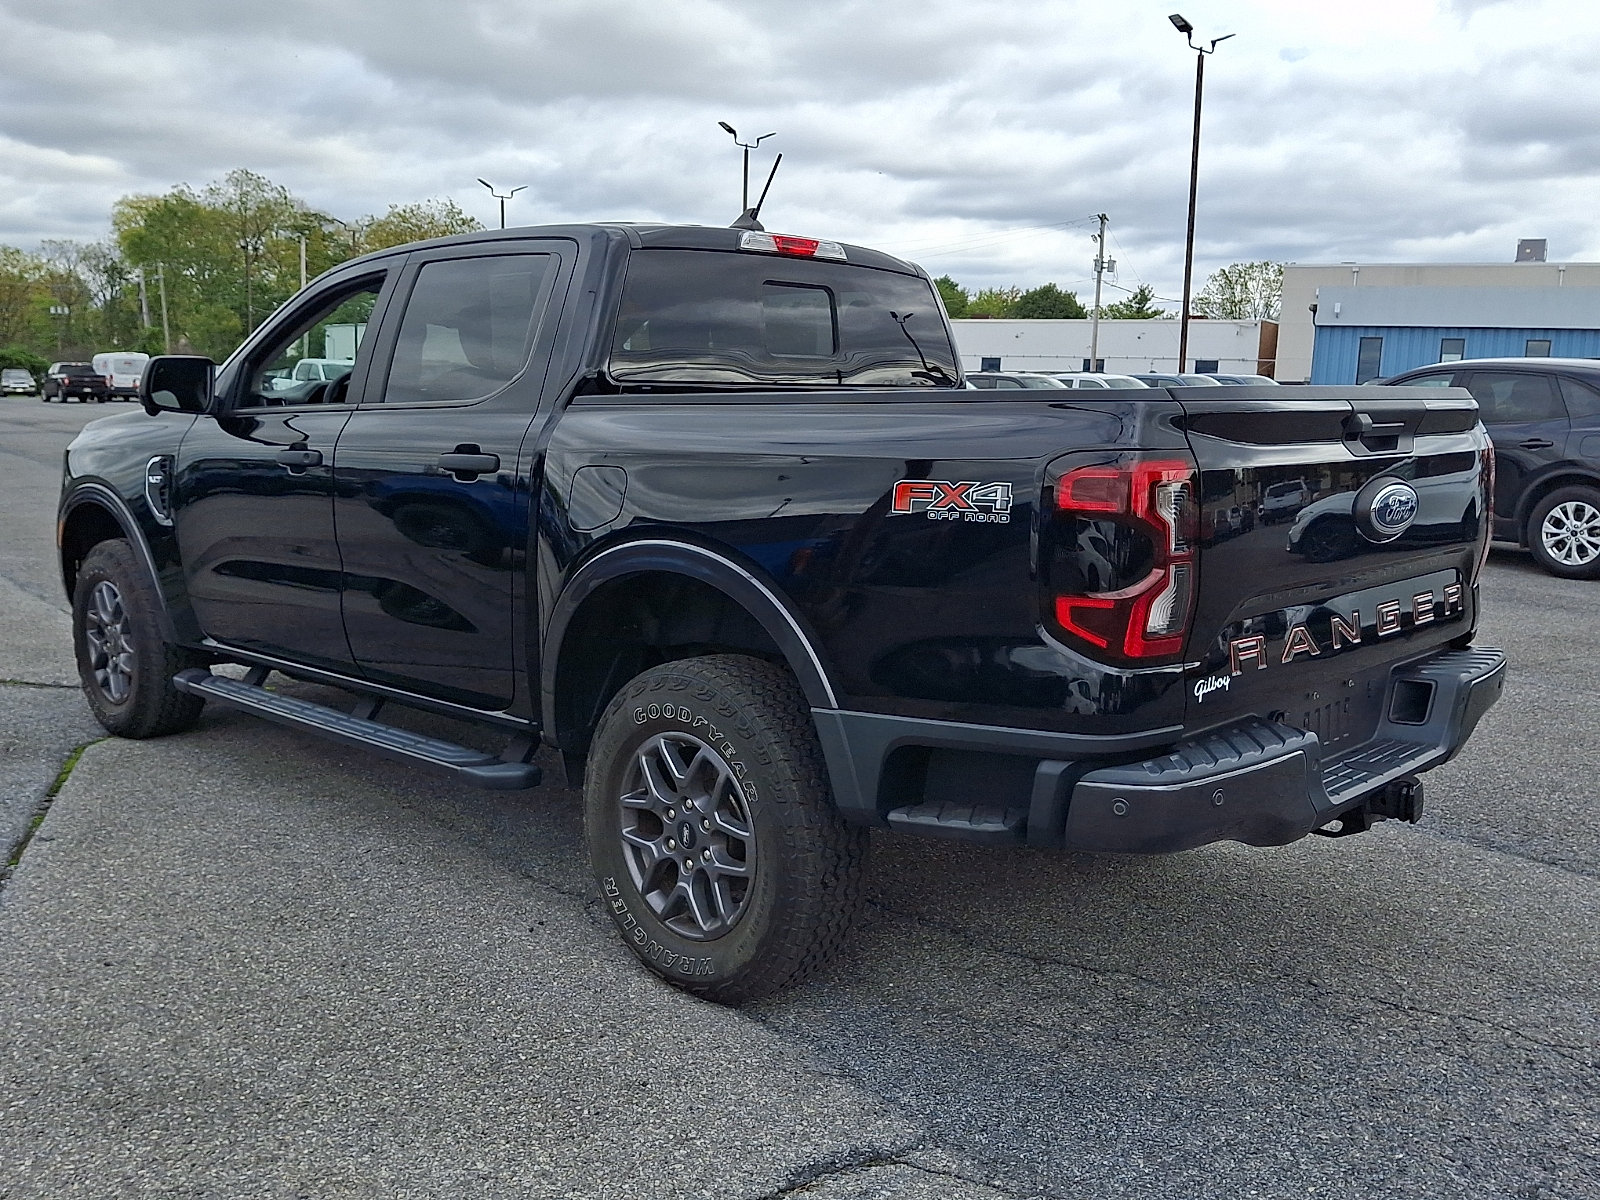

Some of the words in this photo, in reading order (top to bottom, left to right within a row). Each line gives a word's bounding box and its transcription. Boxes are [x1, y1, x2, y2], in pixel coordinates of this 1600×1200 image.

[891, 479, 1013, 514] FX4
[927, 510, 960, 521] OFF
[964, 512, 1010, 523] ROAD
[1230, 583, 1464, 676] RANGER
[1194, 675, 1230, 703] Gilboy
[633, 703, 758, 802] GOODYEAR
[603, 877, 715, 976] WRANGLER
